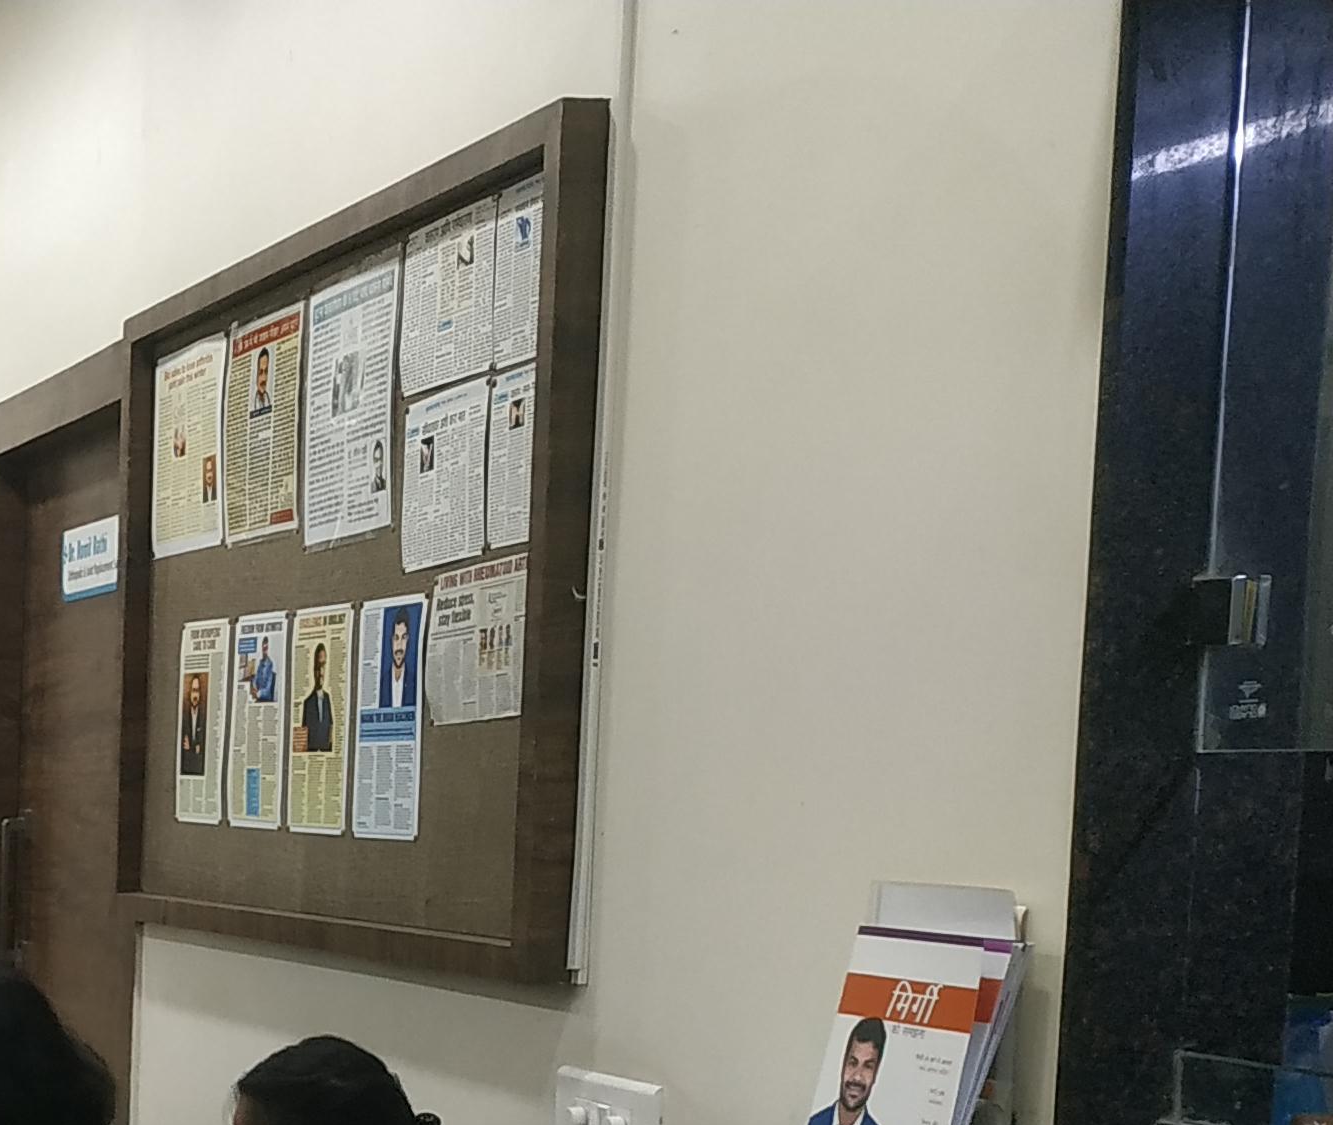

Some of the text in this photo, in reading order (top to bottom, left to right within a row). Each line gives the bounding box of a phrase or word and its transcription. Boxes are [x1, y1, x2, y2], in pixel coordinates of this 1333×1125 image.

[473, 560, 513, 582] RHEUMATOID
[437, 597, 457, 612] Reduce
[438, 608, 472, 628] stay flexible
